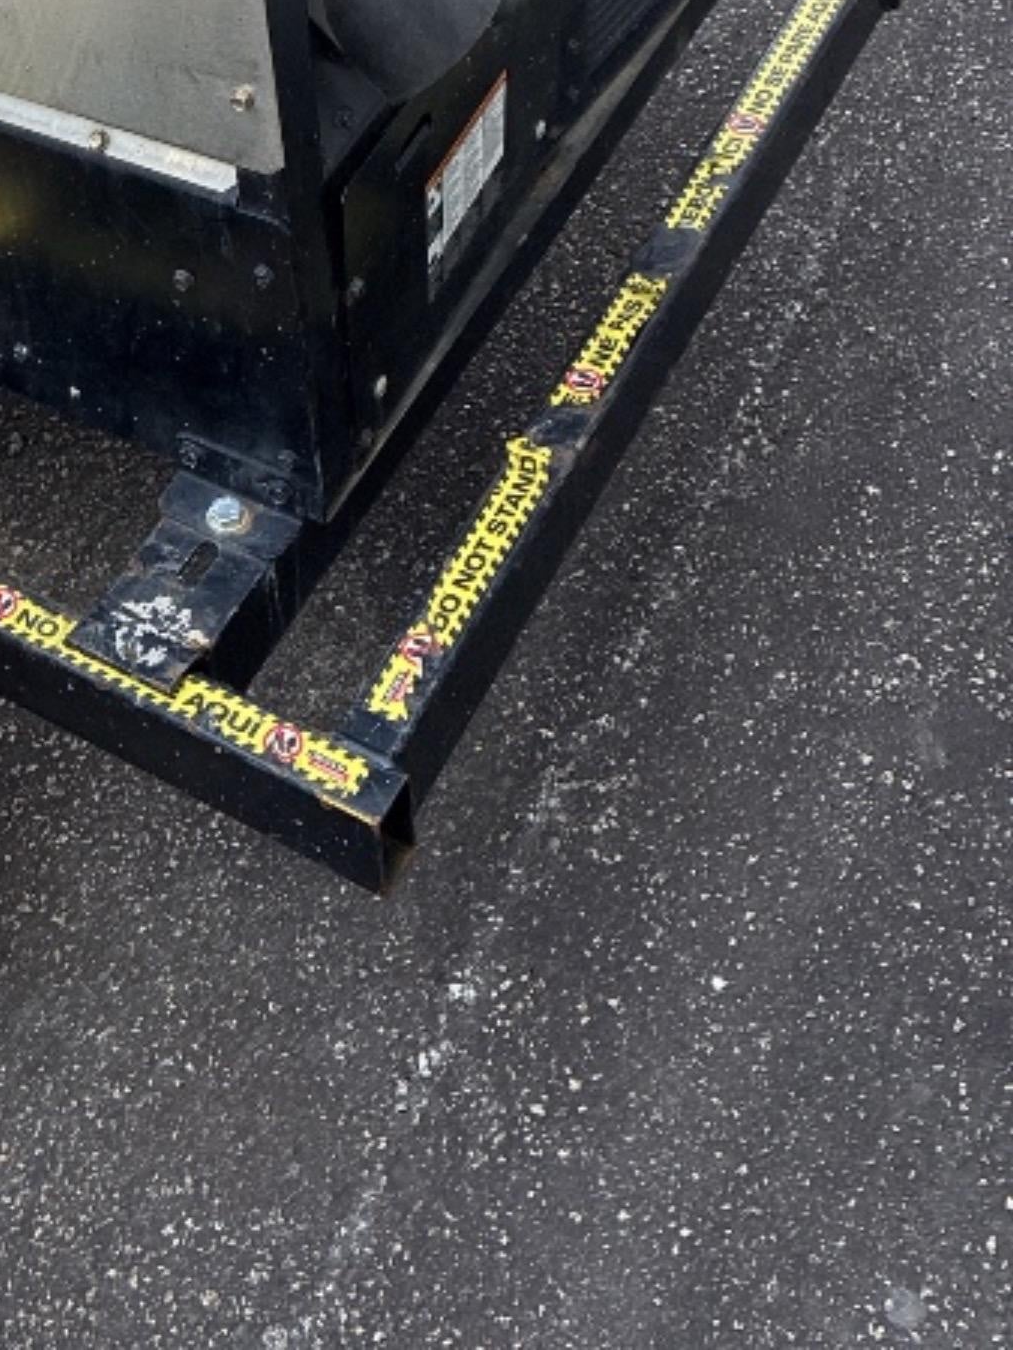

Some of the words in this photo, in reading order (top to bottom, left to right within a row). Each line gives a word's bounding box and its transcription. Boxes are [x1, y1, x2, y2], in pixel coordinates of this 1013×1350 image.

[452, 537, 496, 592] NOT
[488, 454, 537, 536] STAND
[15, 608, 61, 638] NO
